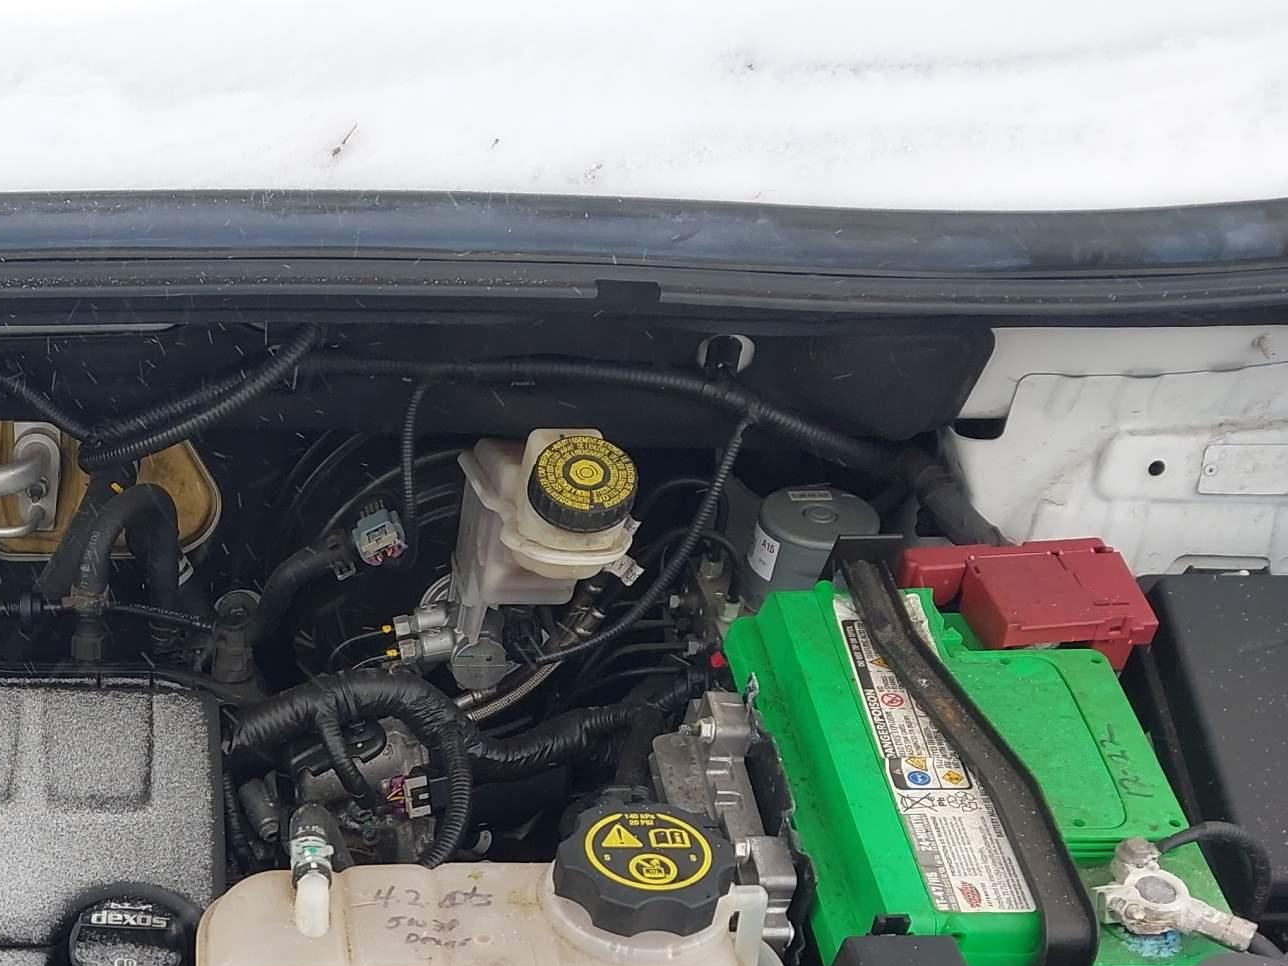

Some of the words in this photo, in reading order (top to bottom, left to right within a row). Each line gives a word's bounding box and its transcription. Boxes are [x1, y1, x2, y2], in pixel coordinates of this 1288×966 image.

[761, 538, 776, 554] A15
[937, 797, 946, 806] Pb
[911, 814, 931, 850] 24-MONTH
[90, 910, 170, 928] dexos
